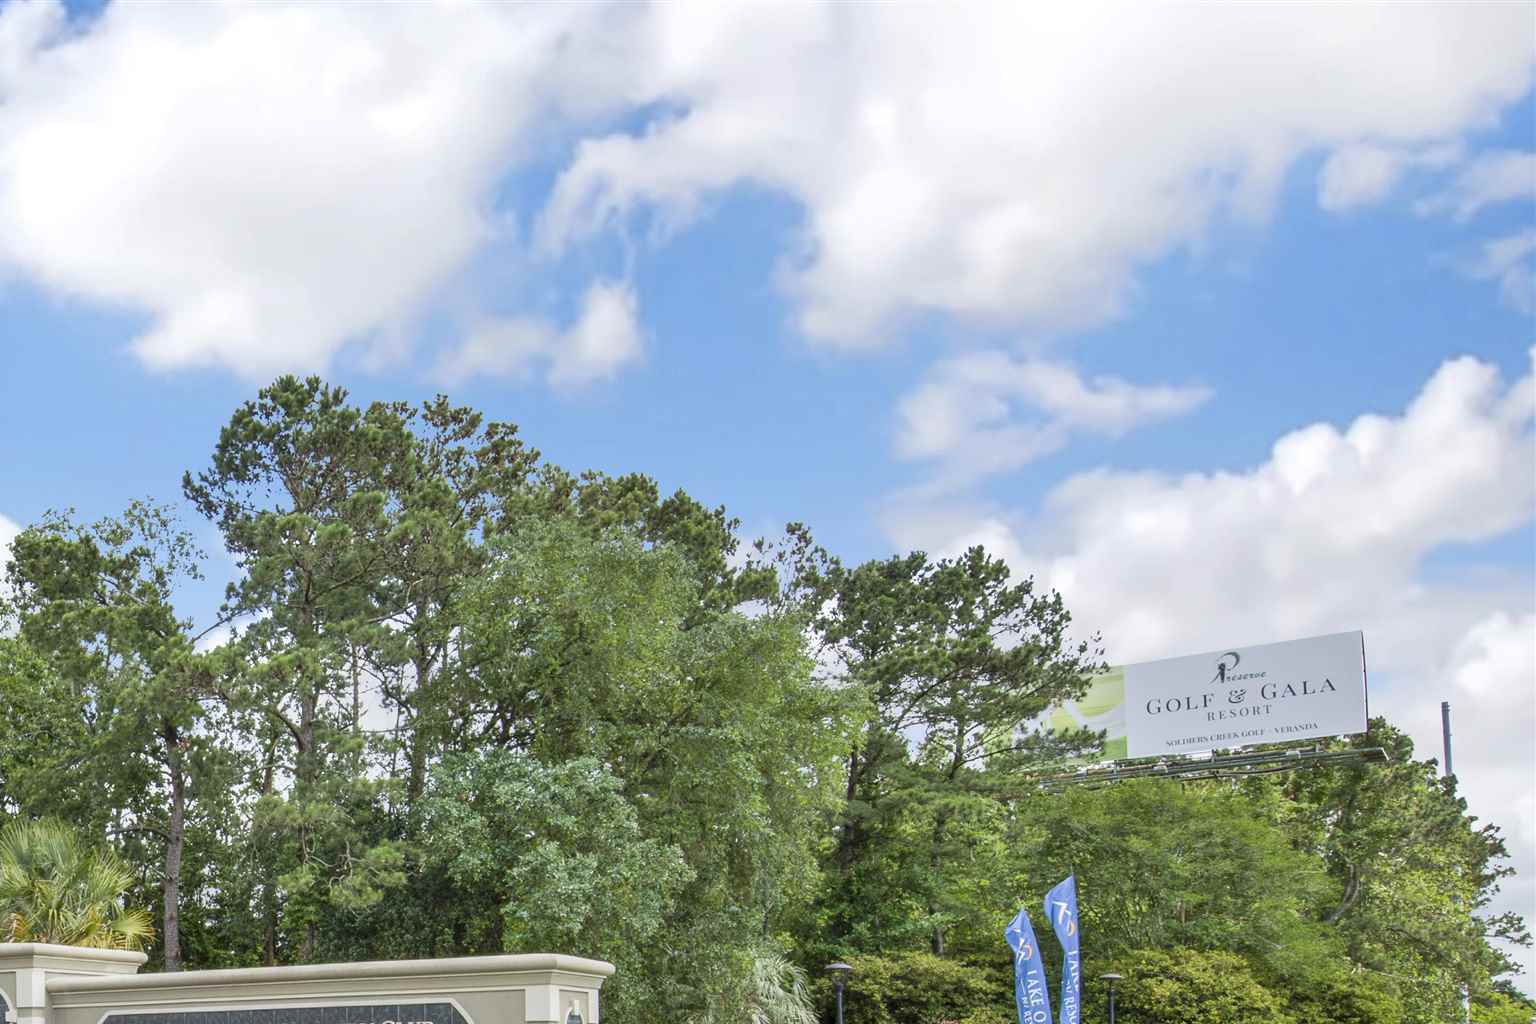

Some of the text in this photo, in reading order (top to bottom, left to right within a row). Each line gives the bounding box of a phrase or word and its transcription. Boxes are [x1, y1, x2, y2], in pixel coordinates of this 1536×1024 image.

[1146, 678, 1336, 715] GOLF & GALA
[1207, 704, 1272, 721] RESORT
[1241, 728, 1264, 738] GOLF
[1274, 721, 1318, 734] VERANDA
